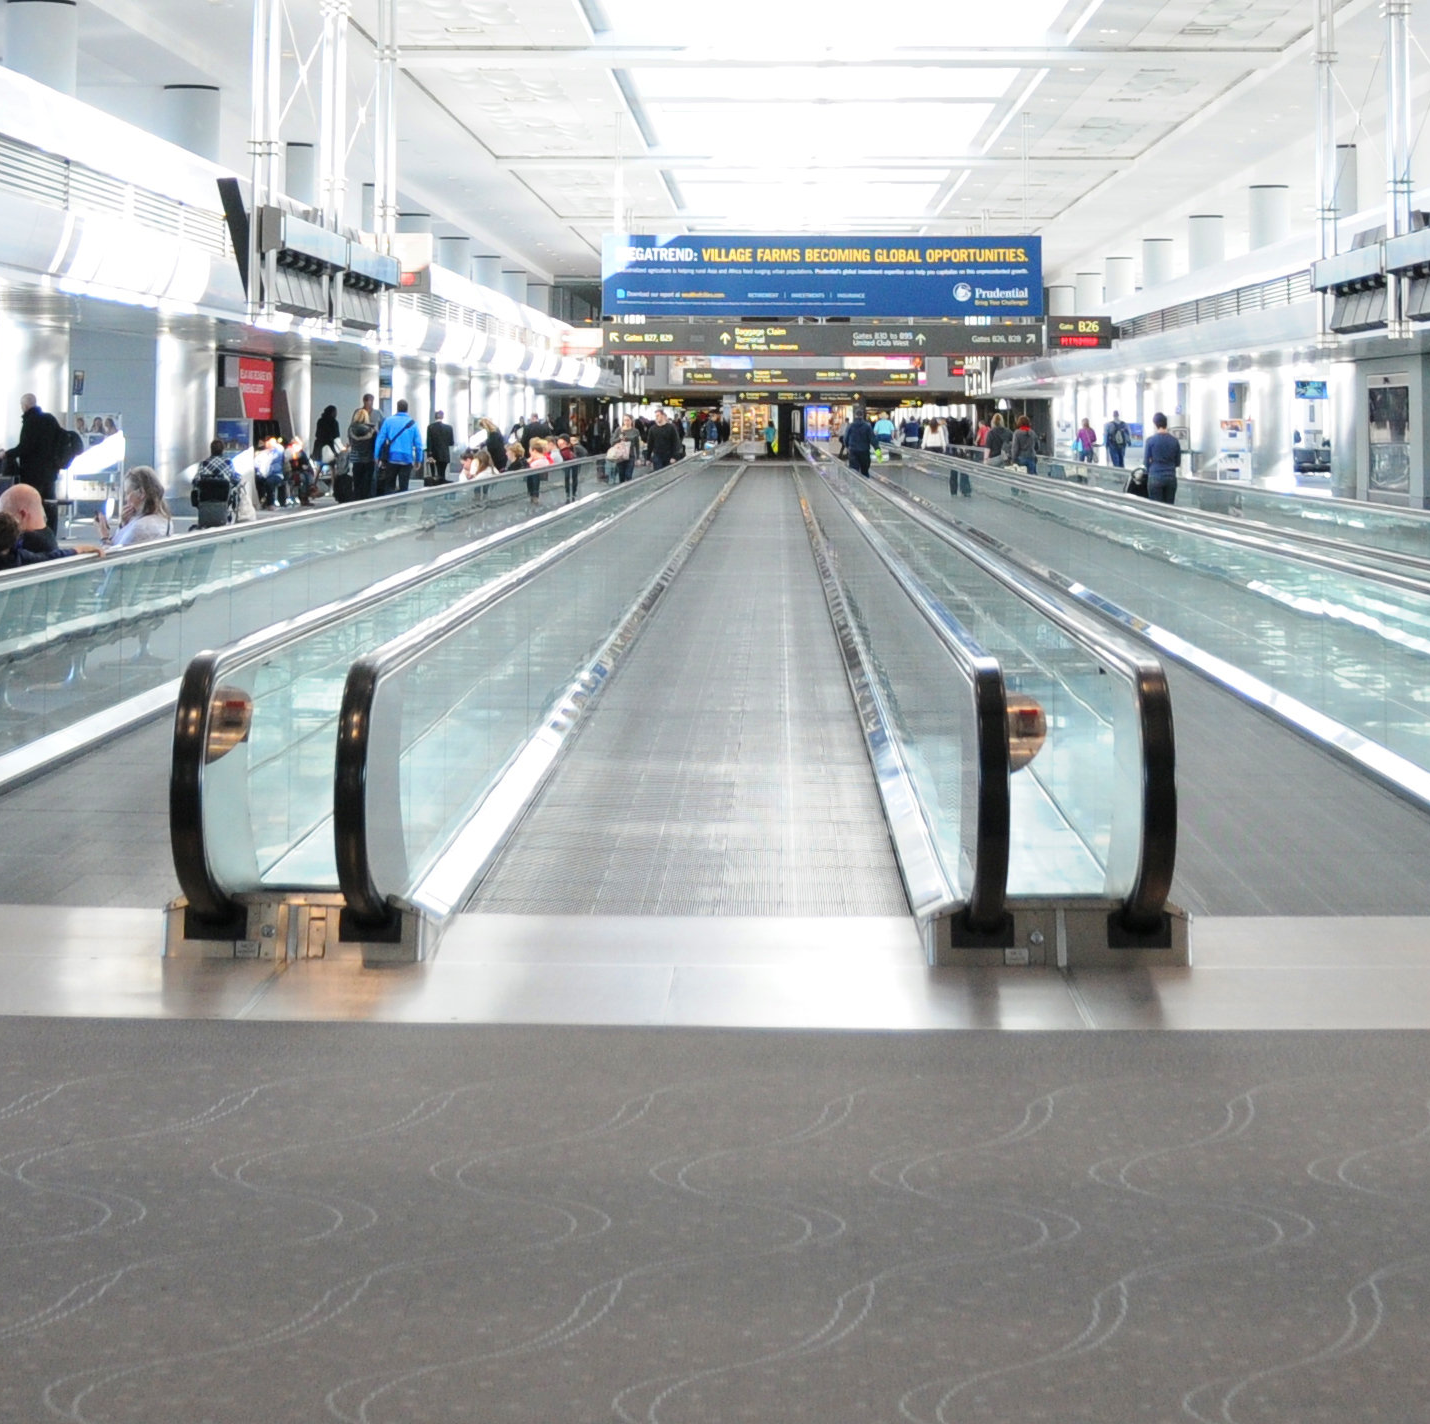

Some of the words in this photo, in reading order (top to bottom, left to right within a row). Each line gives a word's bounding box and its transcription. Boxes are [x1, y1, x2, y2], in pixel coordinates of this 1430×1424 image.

[617, 247, 698, 262] EGATREND:
[702, 248, 752, 262] VILLAGE
[757, 248, 800, 262] FARMS
[805, 248, 870, 262] BECOMING
[874, 248, 922, 262] GLOBAL
[926, 248, 1029, 262] OPPORTUNITIES.
[975, 287, 1029, 298] Prudential
[1077, 320, 1099, 332] B26
